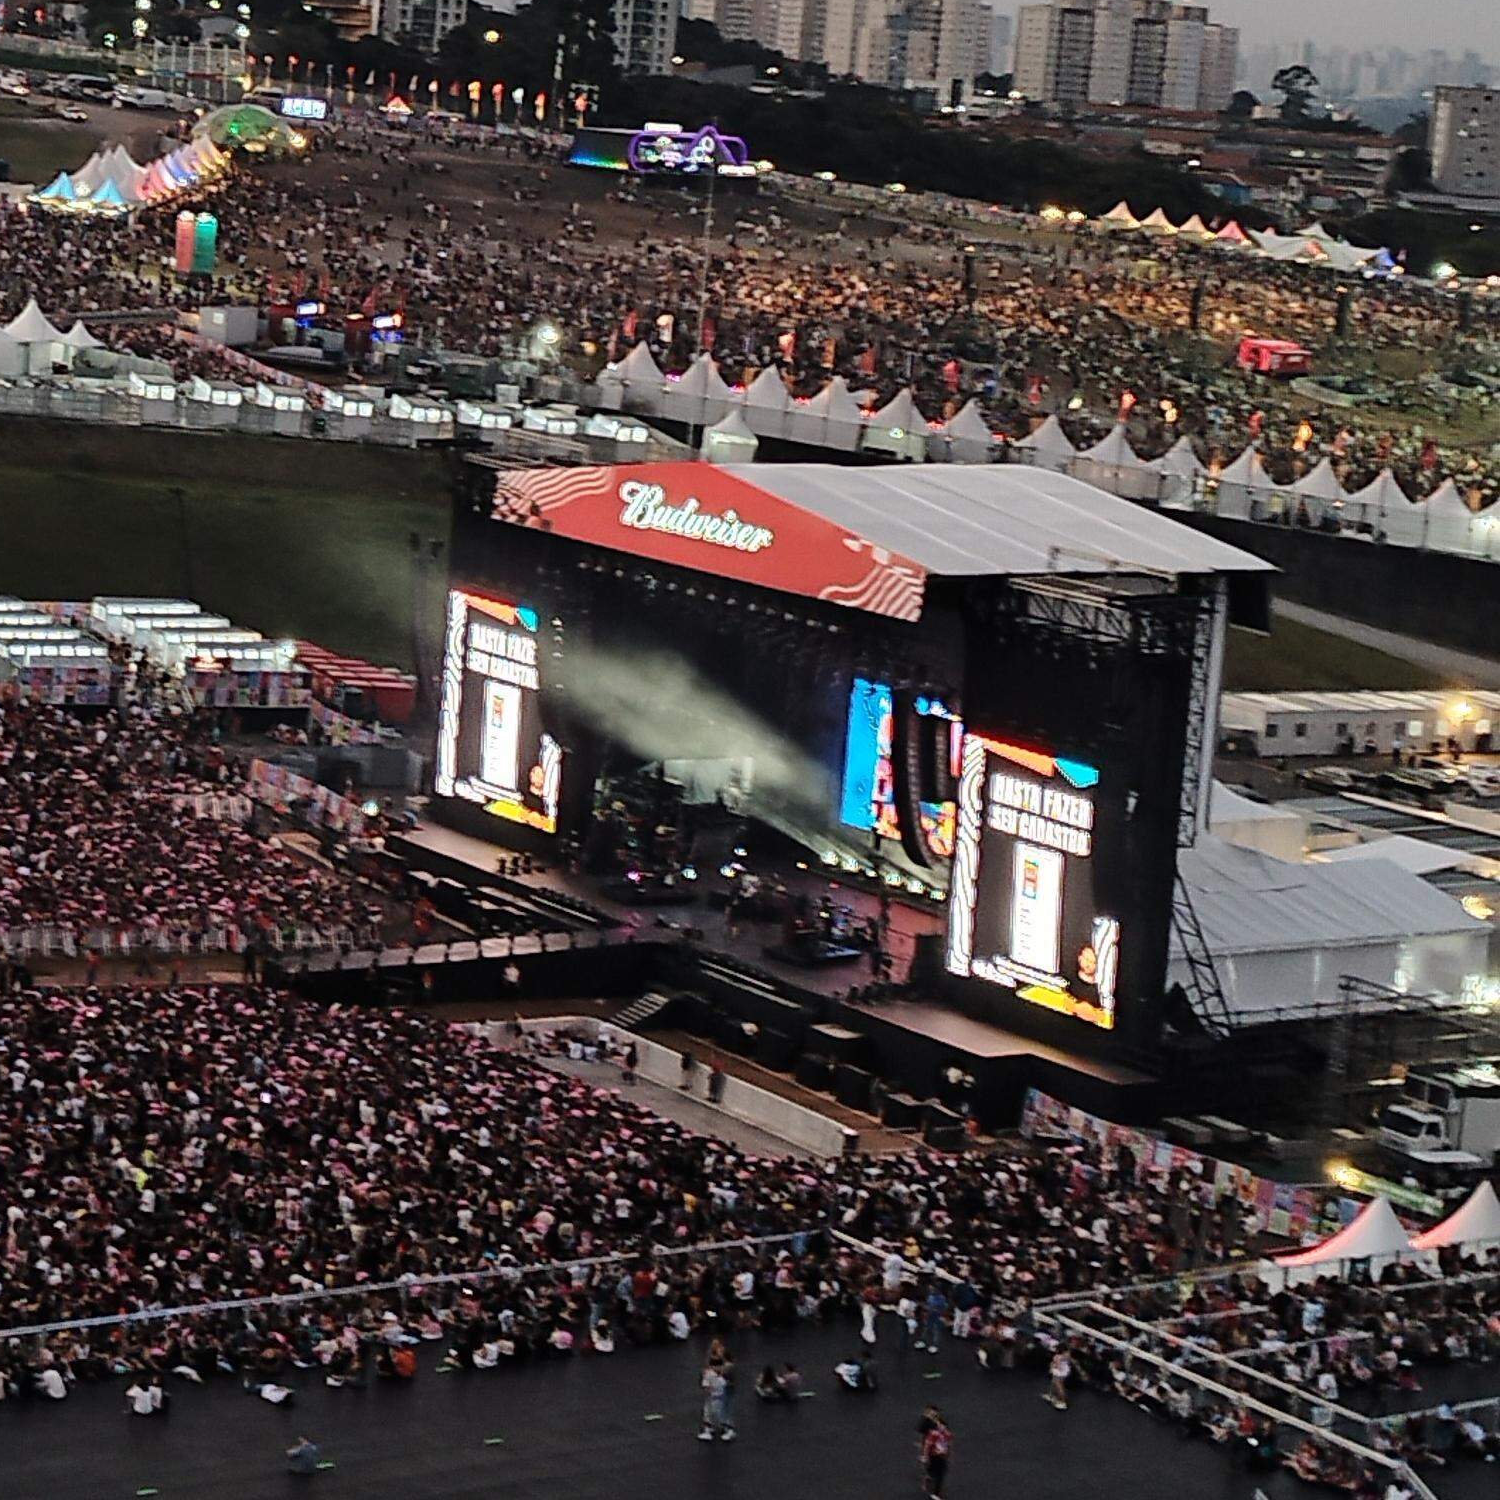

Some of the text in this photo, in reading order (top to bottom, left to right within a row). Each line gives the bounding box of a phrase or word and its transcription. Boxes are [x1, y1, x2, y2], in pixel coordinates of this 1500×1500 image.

[619, 481, 775, 553] Budweiser
[988, 803, 1092, 857] SEU CADASTRO
[990, 772, 1095, 831] BASTA FAZER
